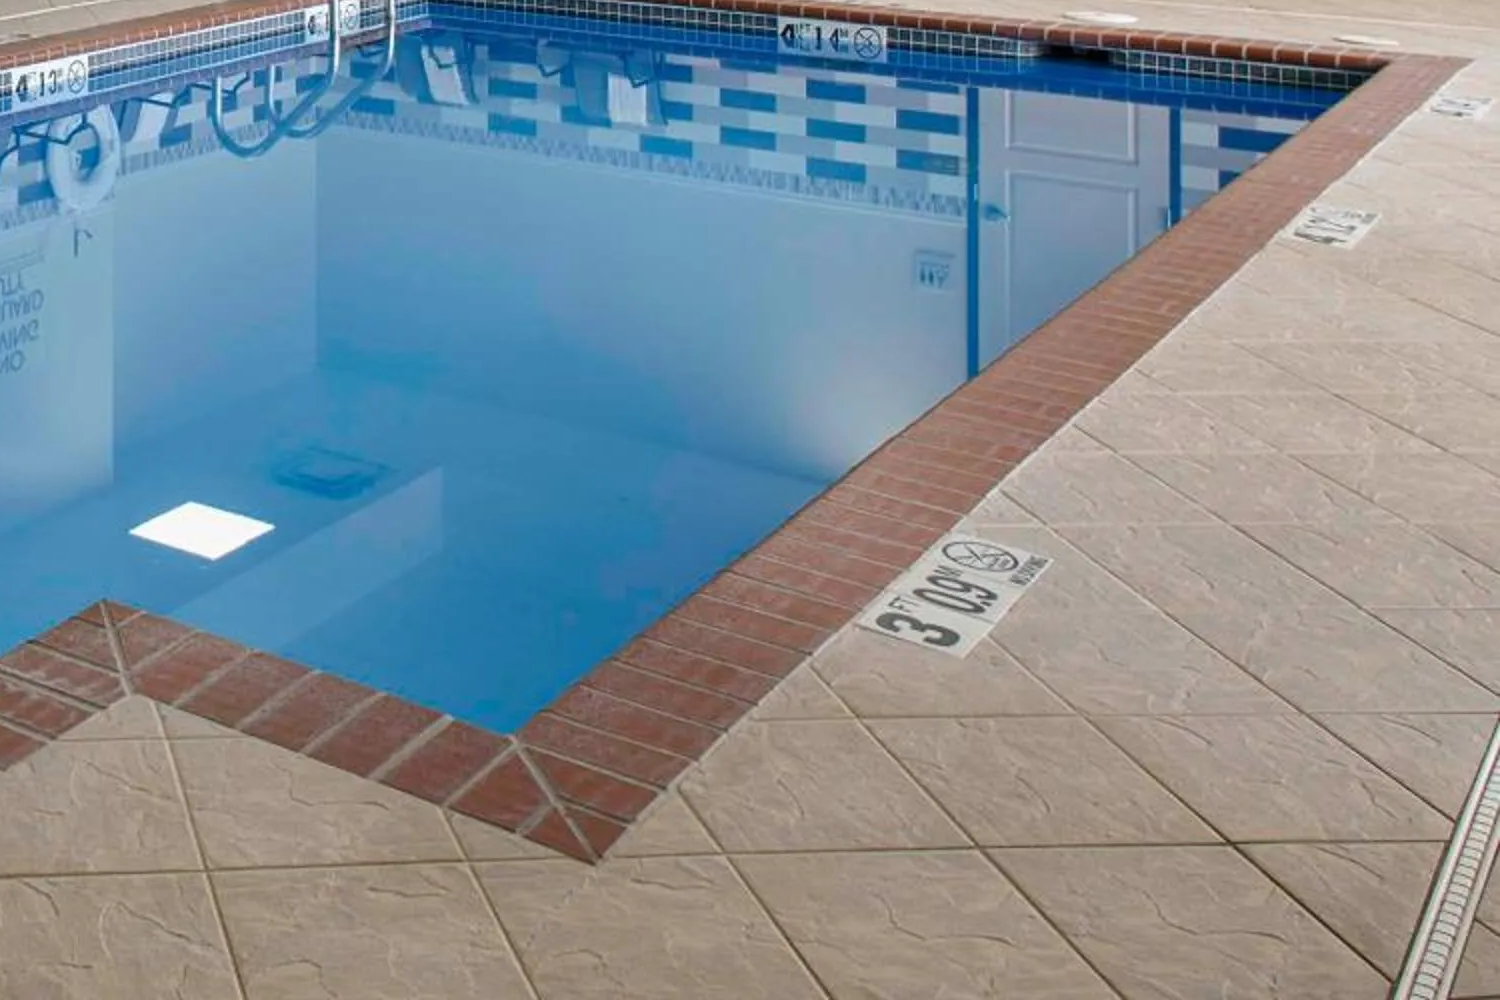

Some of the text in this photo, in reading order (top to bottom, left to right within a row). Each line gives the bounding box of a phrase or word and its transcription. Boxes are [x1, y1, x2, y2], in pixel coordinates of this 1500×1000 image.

[888, 596, 923, 613] FT
[913, 575, 998, 614] 0.9
[875, 612, 960, 647] 3
